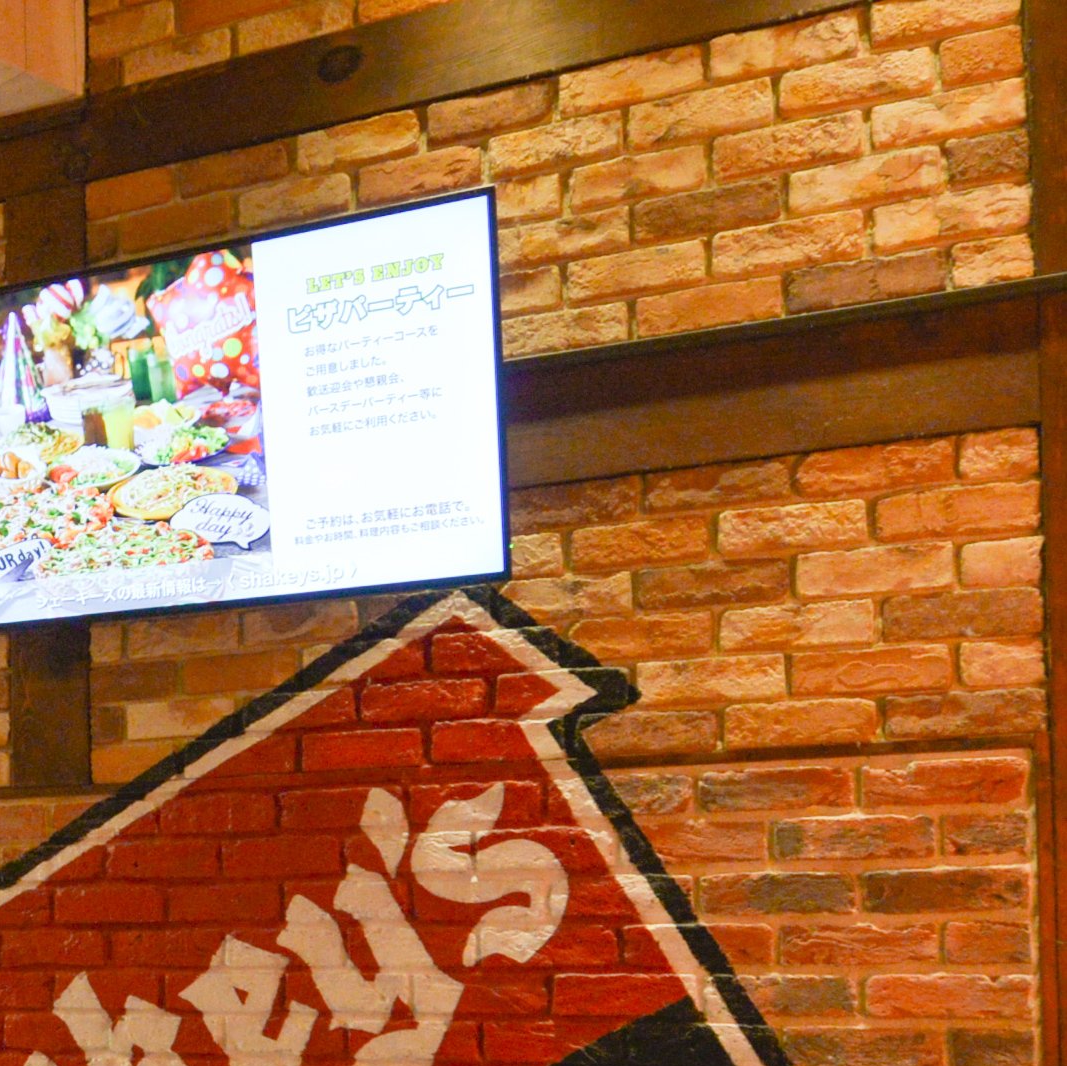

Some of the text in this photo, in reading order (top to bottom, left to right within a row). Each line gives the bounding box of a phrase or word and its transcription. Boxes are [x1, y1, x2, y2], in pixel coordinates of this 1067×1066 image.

[371, 252, 445, 283] ENJOY
[286, 283, 475, 334] ピザパーティー
[304, 325, 439, 358] お得なパーティーコースを
[305, 356, 387, 378] ご用意しました。
[309, 409, 438, 437] お気軽にご利用ください。
[190, 498, 254, 527] Happy
[305, 500, 471, 531] ご予約は、お気軽にお電話で。
[196, 518, 231, 540] day
[18, 540, 47, 566] day!
